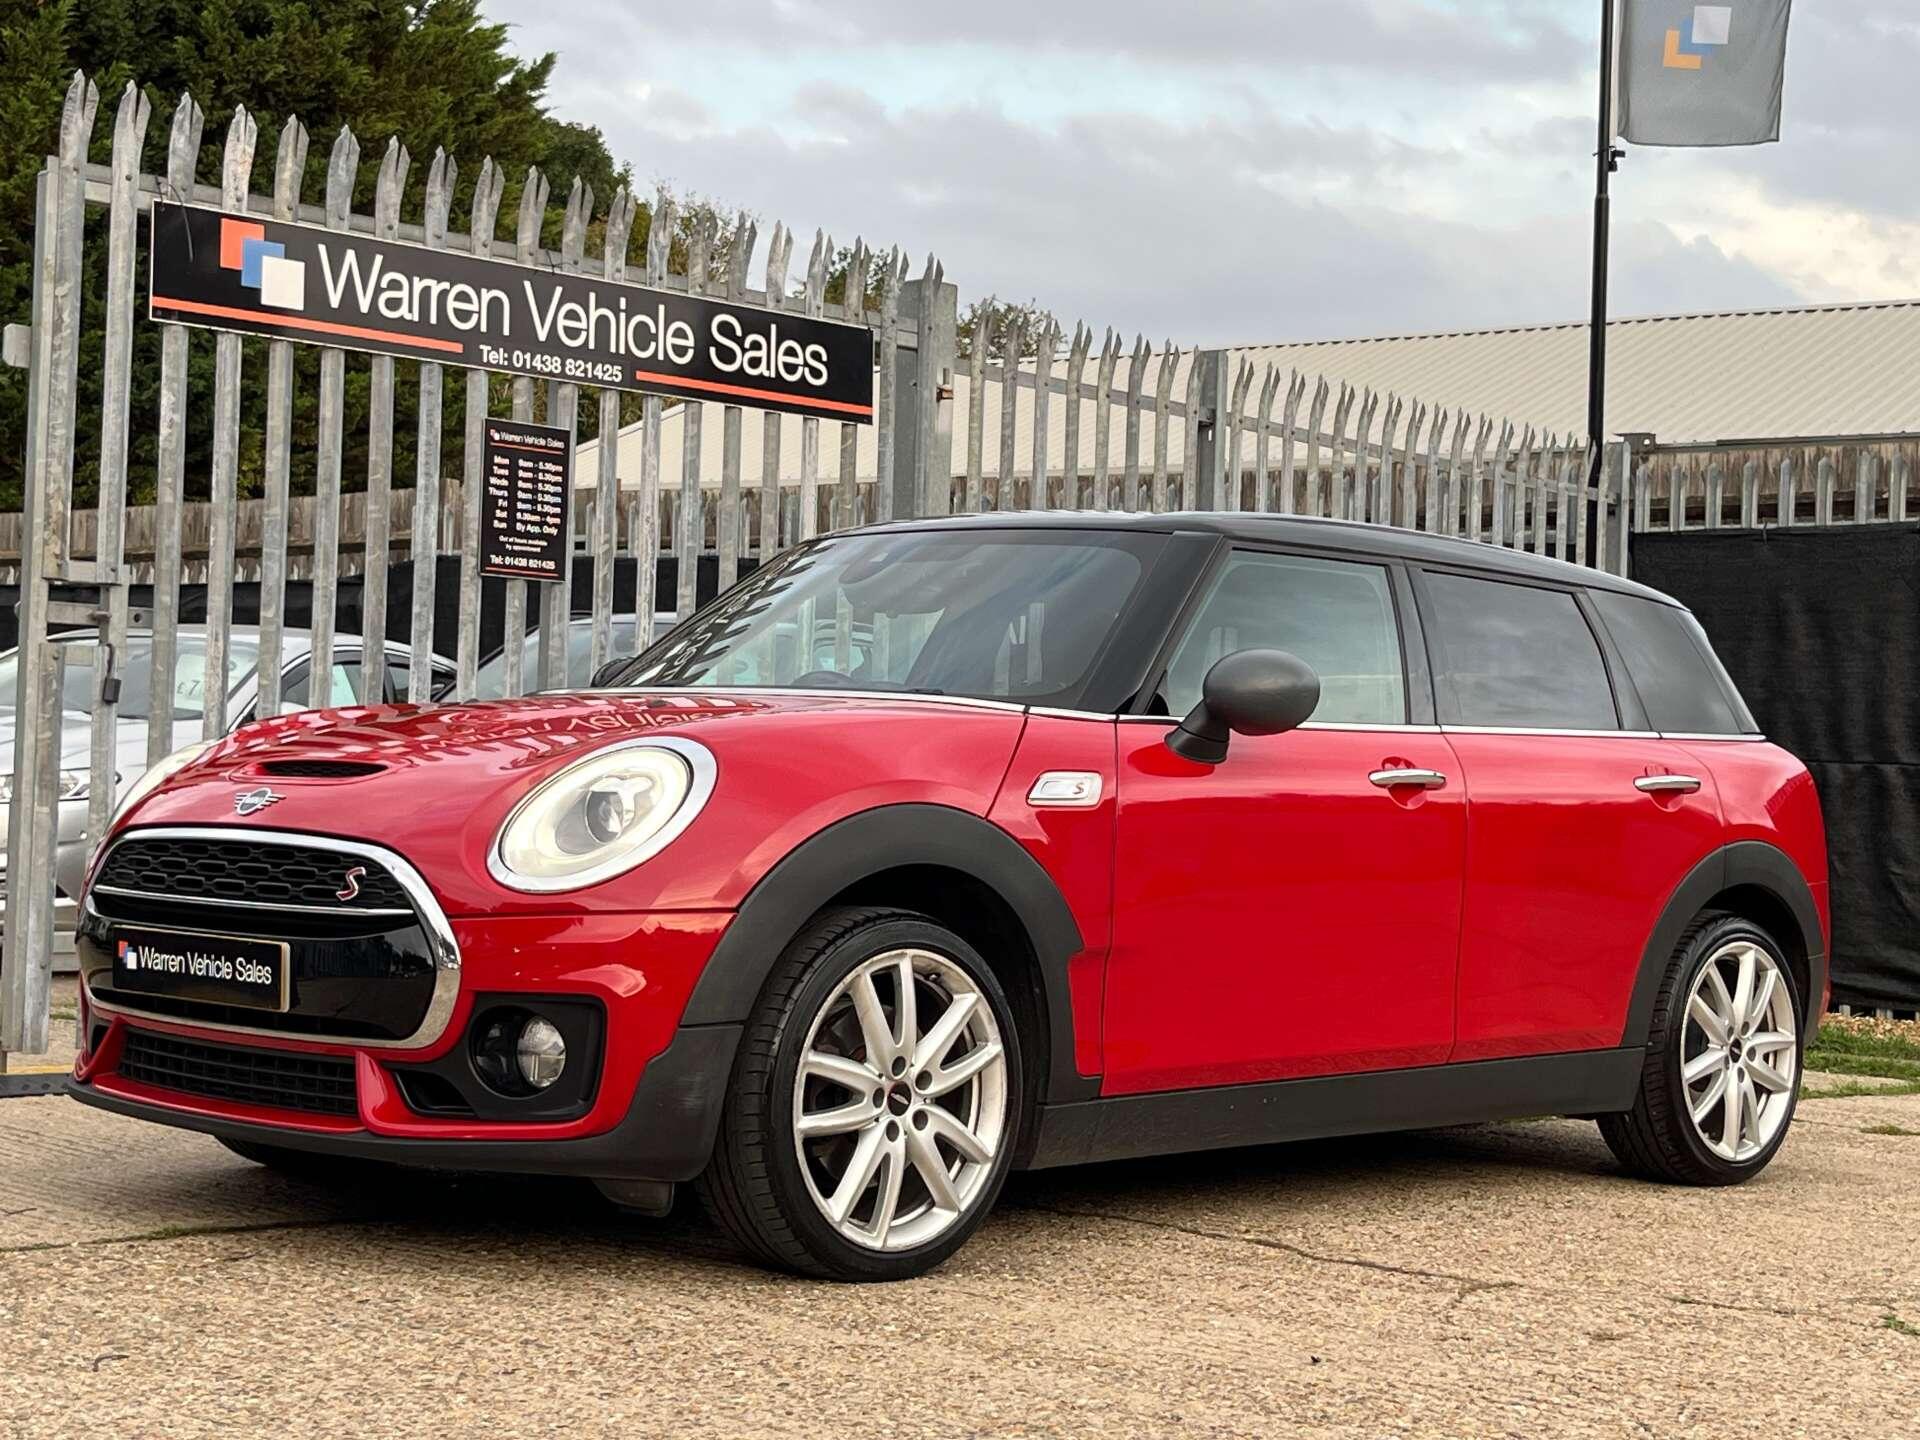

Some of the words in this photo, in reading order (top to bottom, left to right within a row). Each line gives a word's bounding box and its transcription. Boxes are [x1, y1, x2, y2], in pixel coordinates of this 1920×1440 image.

[318, 243, 510, 336] Warren
[523, 280, 695, 365] Vehicle
[709, 313, 828, 386] Sales
[479, 344, 508, 366] Tel:
[512, 350, 562, 374] 01438
[565, 358, 623, 383] 821425
[500, 431, 523, 443] Warren
[524, 435, 546, 447] Vehicle
[547, 437, 565, 449] Sales
[138, 945, 185, 974] Warren
[187, 951, 233, 980] Vehicle
[235, 957, 272, 985] Sales
